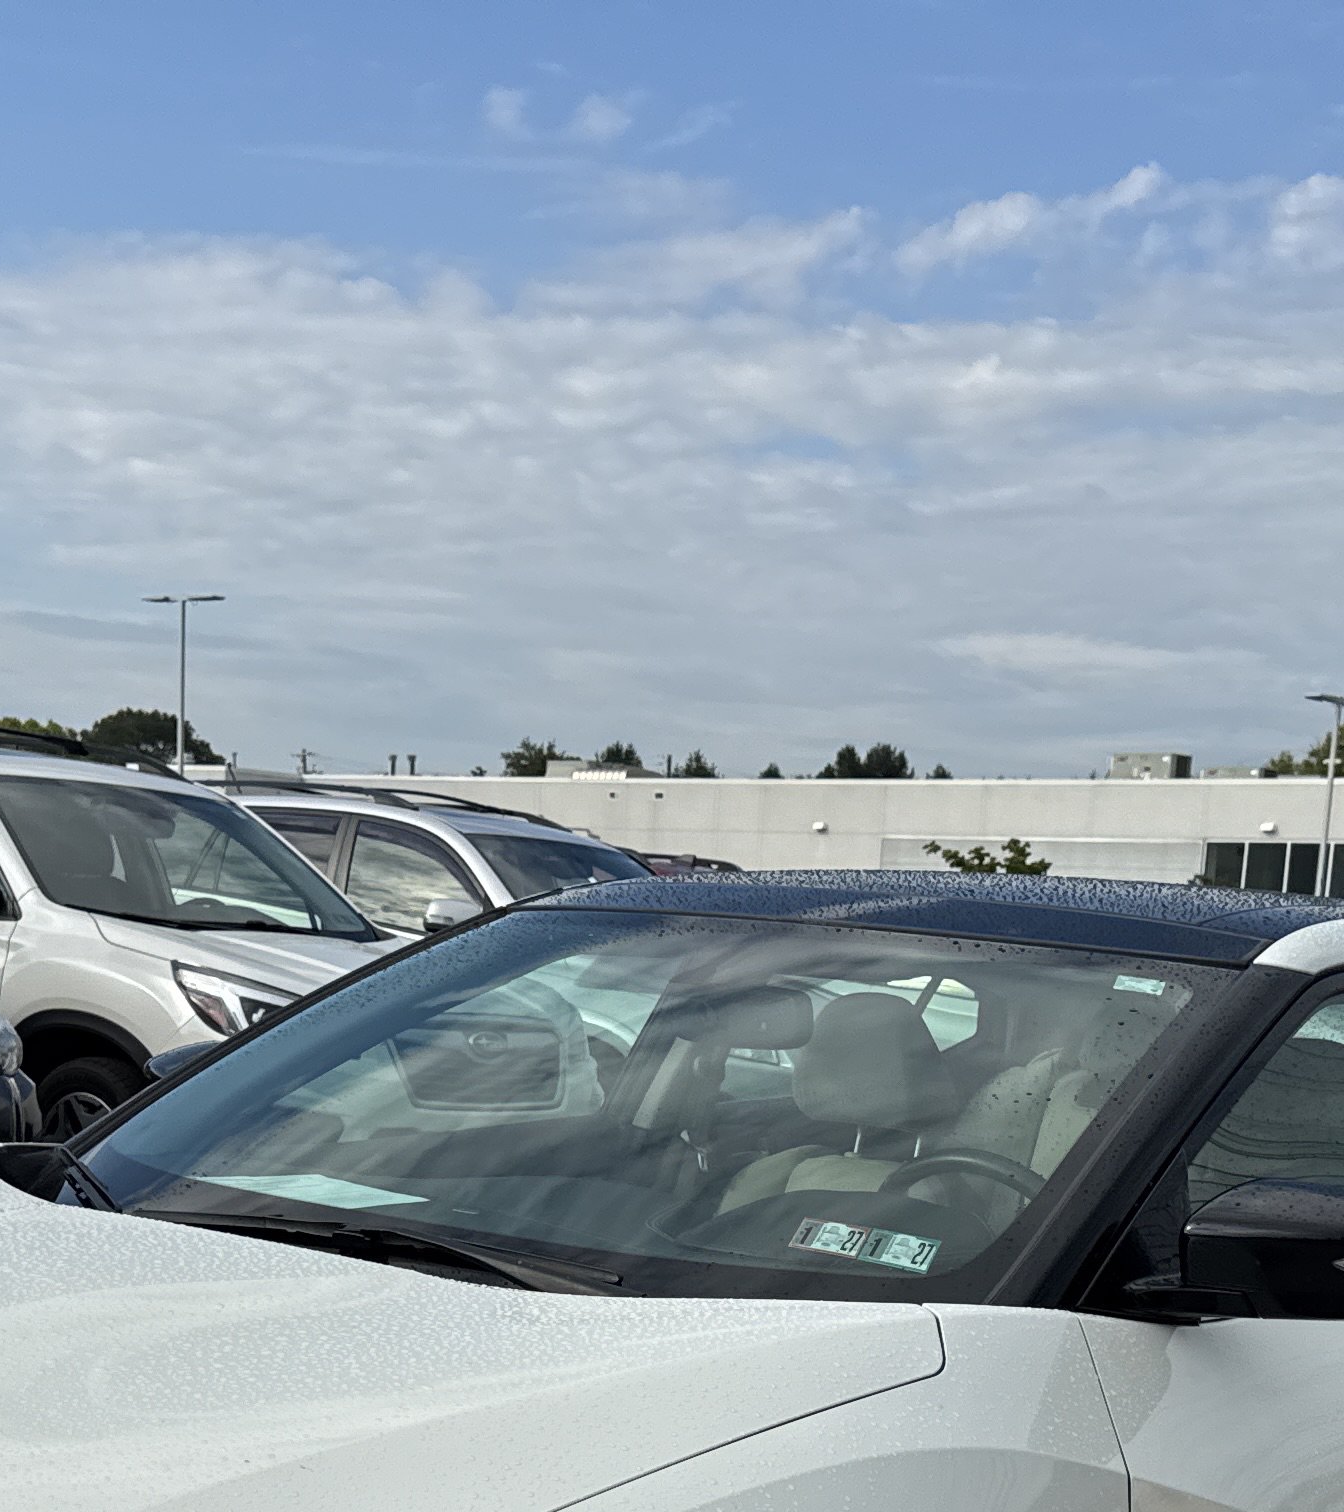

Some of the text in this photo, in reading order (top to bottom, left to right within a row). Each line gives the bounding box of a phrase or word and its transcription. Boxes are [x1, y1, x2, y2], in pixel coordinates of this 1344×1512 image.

[800, 1226, 865, 1253] 1 27
[868, 1237, 935, 1268] 1 27
